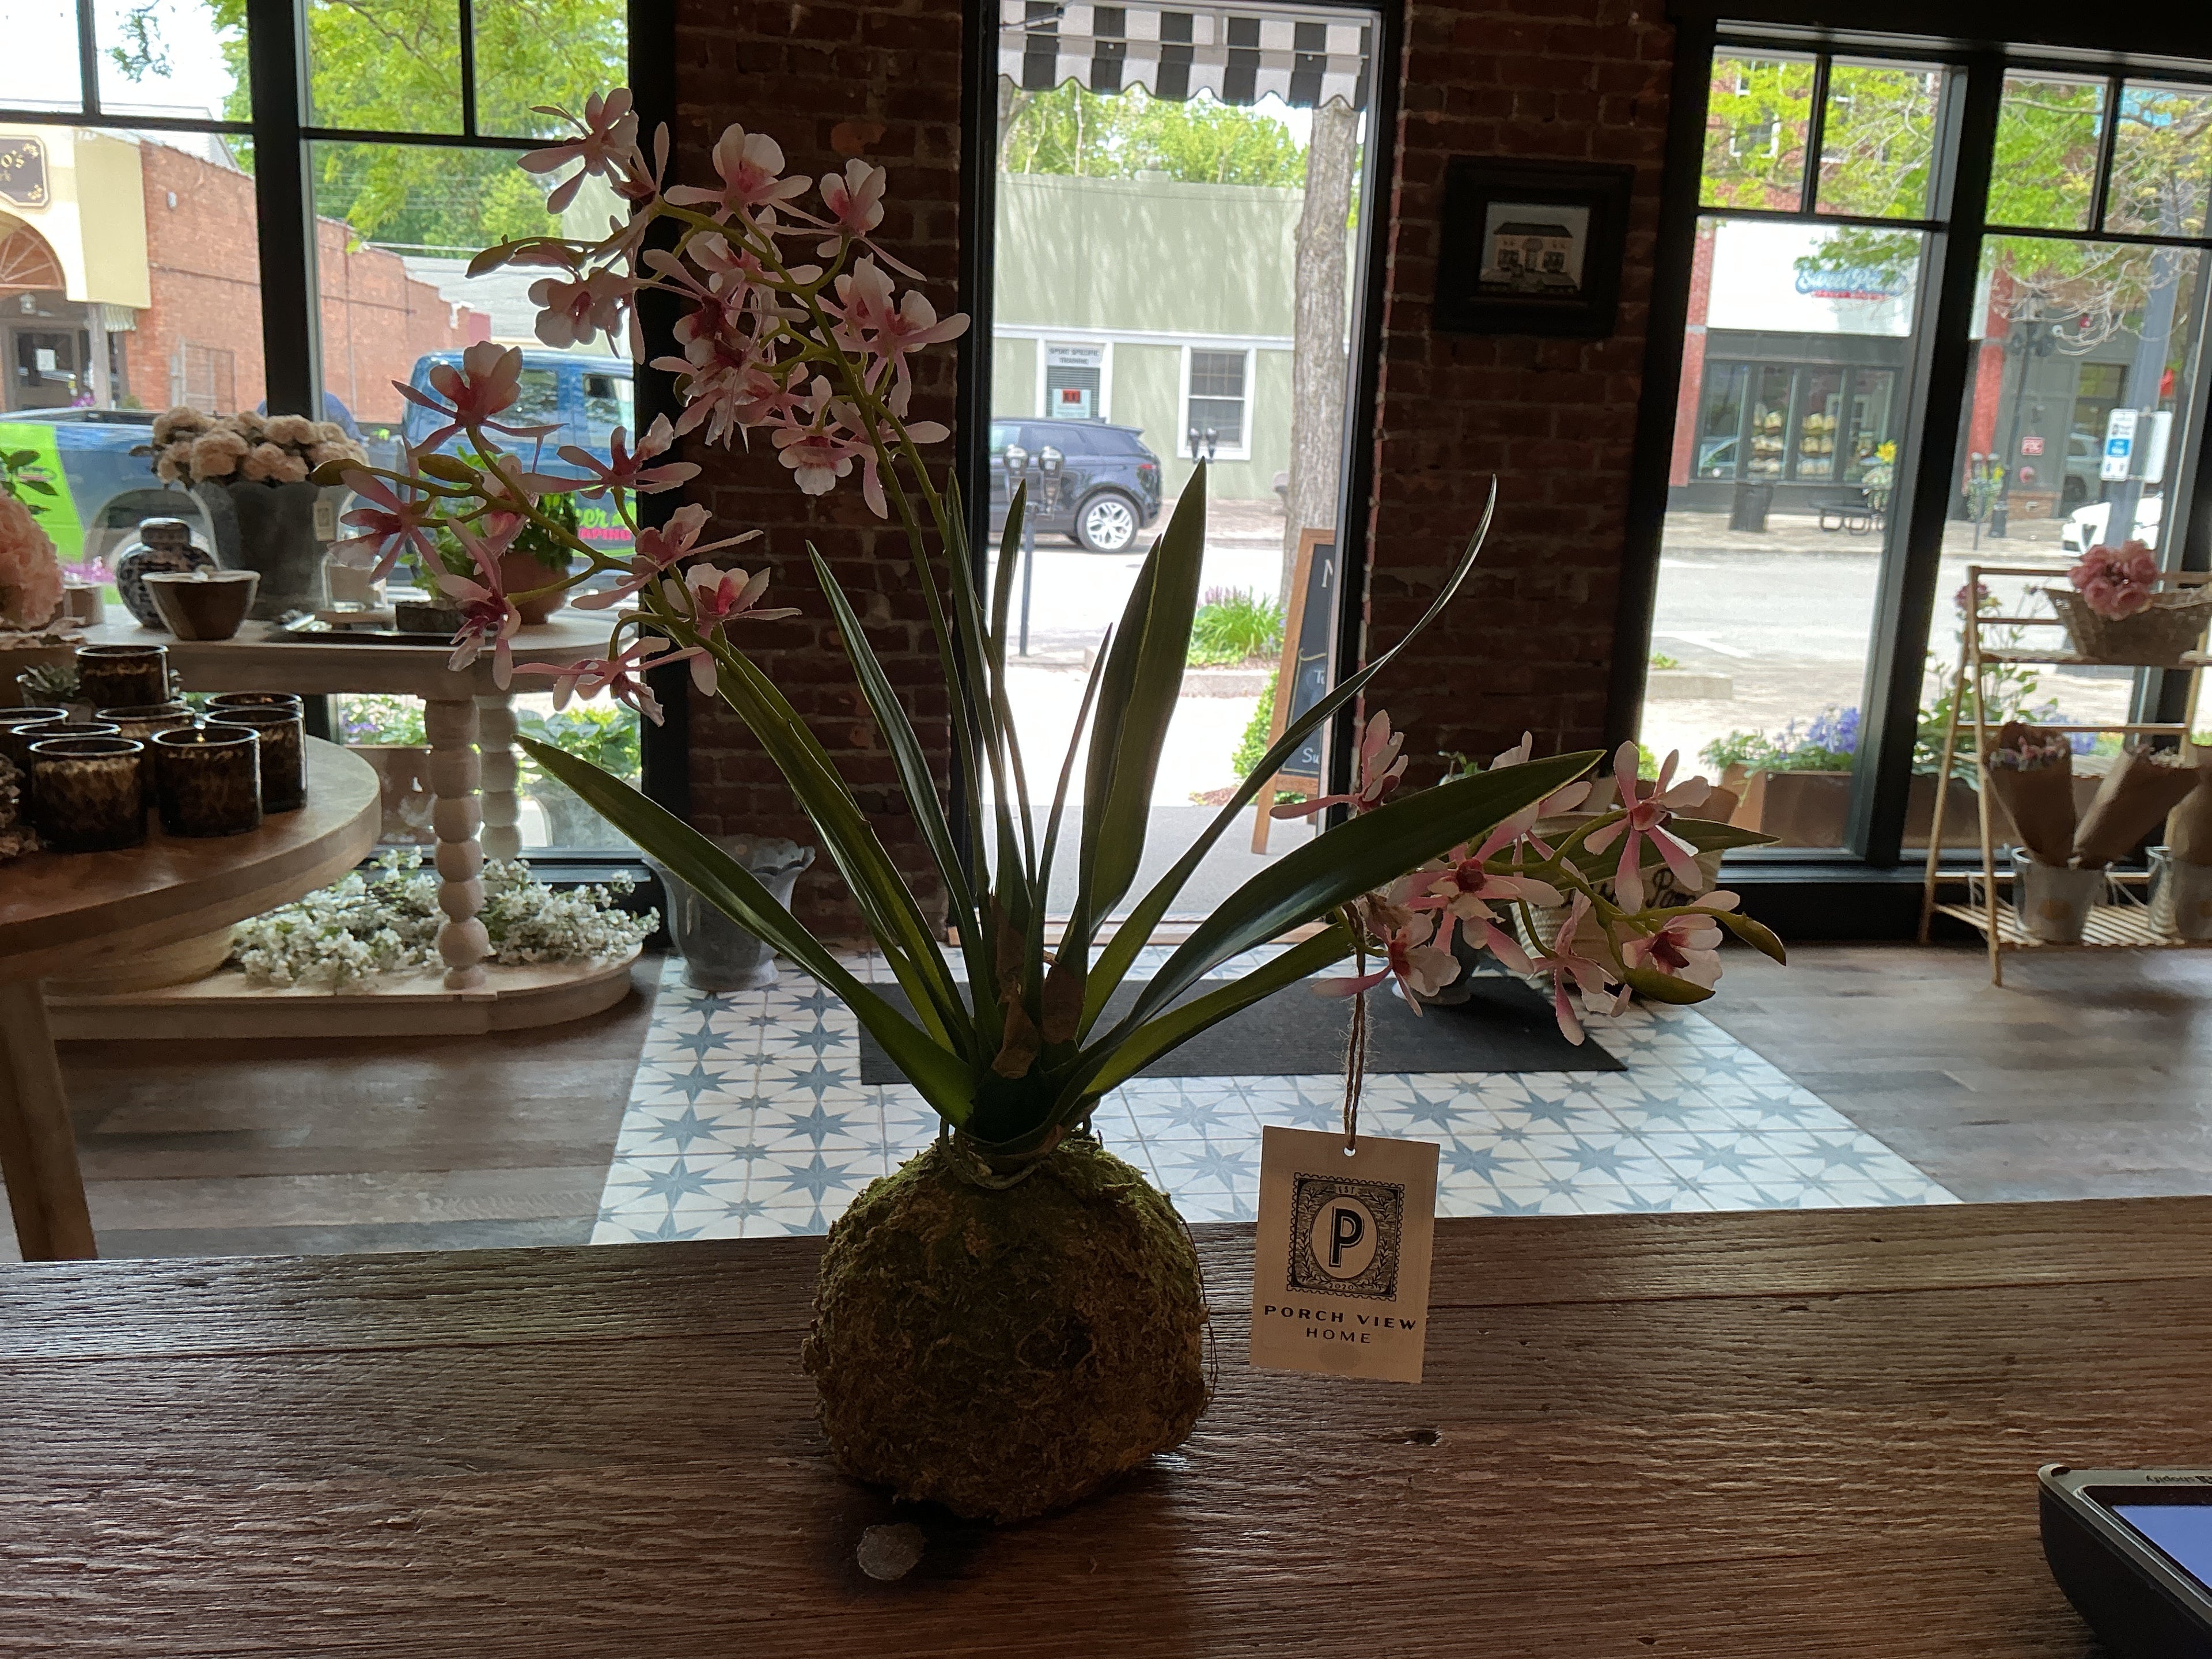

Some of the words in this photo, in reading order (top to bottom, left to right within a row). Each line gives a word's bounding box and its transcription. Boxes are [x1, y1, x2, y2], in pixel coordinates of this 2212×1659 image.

[1, 150, 24, 168] o's
[1328, 1206, 1365, 1267] P
[1330, 1282, 1354, 1290] 2020
[1264, 1305, 1343, 1323] PORCH
[1357, 1315, 1416, 1331] VIEW
[1306, 1327, 1370, 1343] HOME
